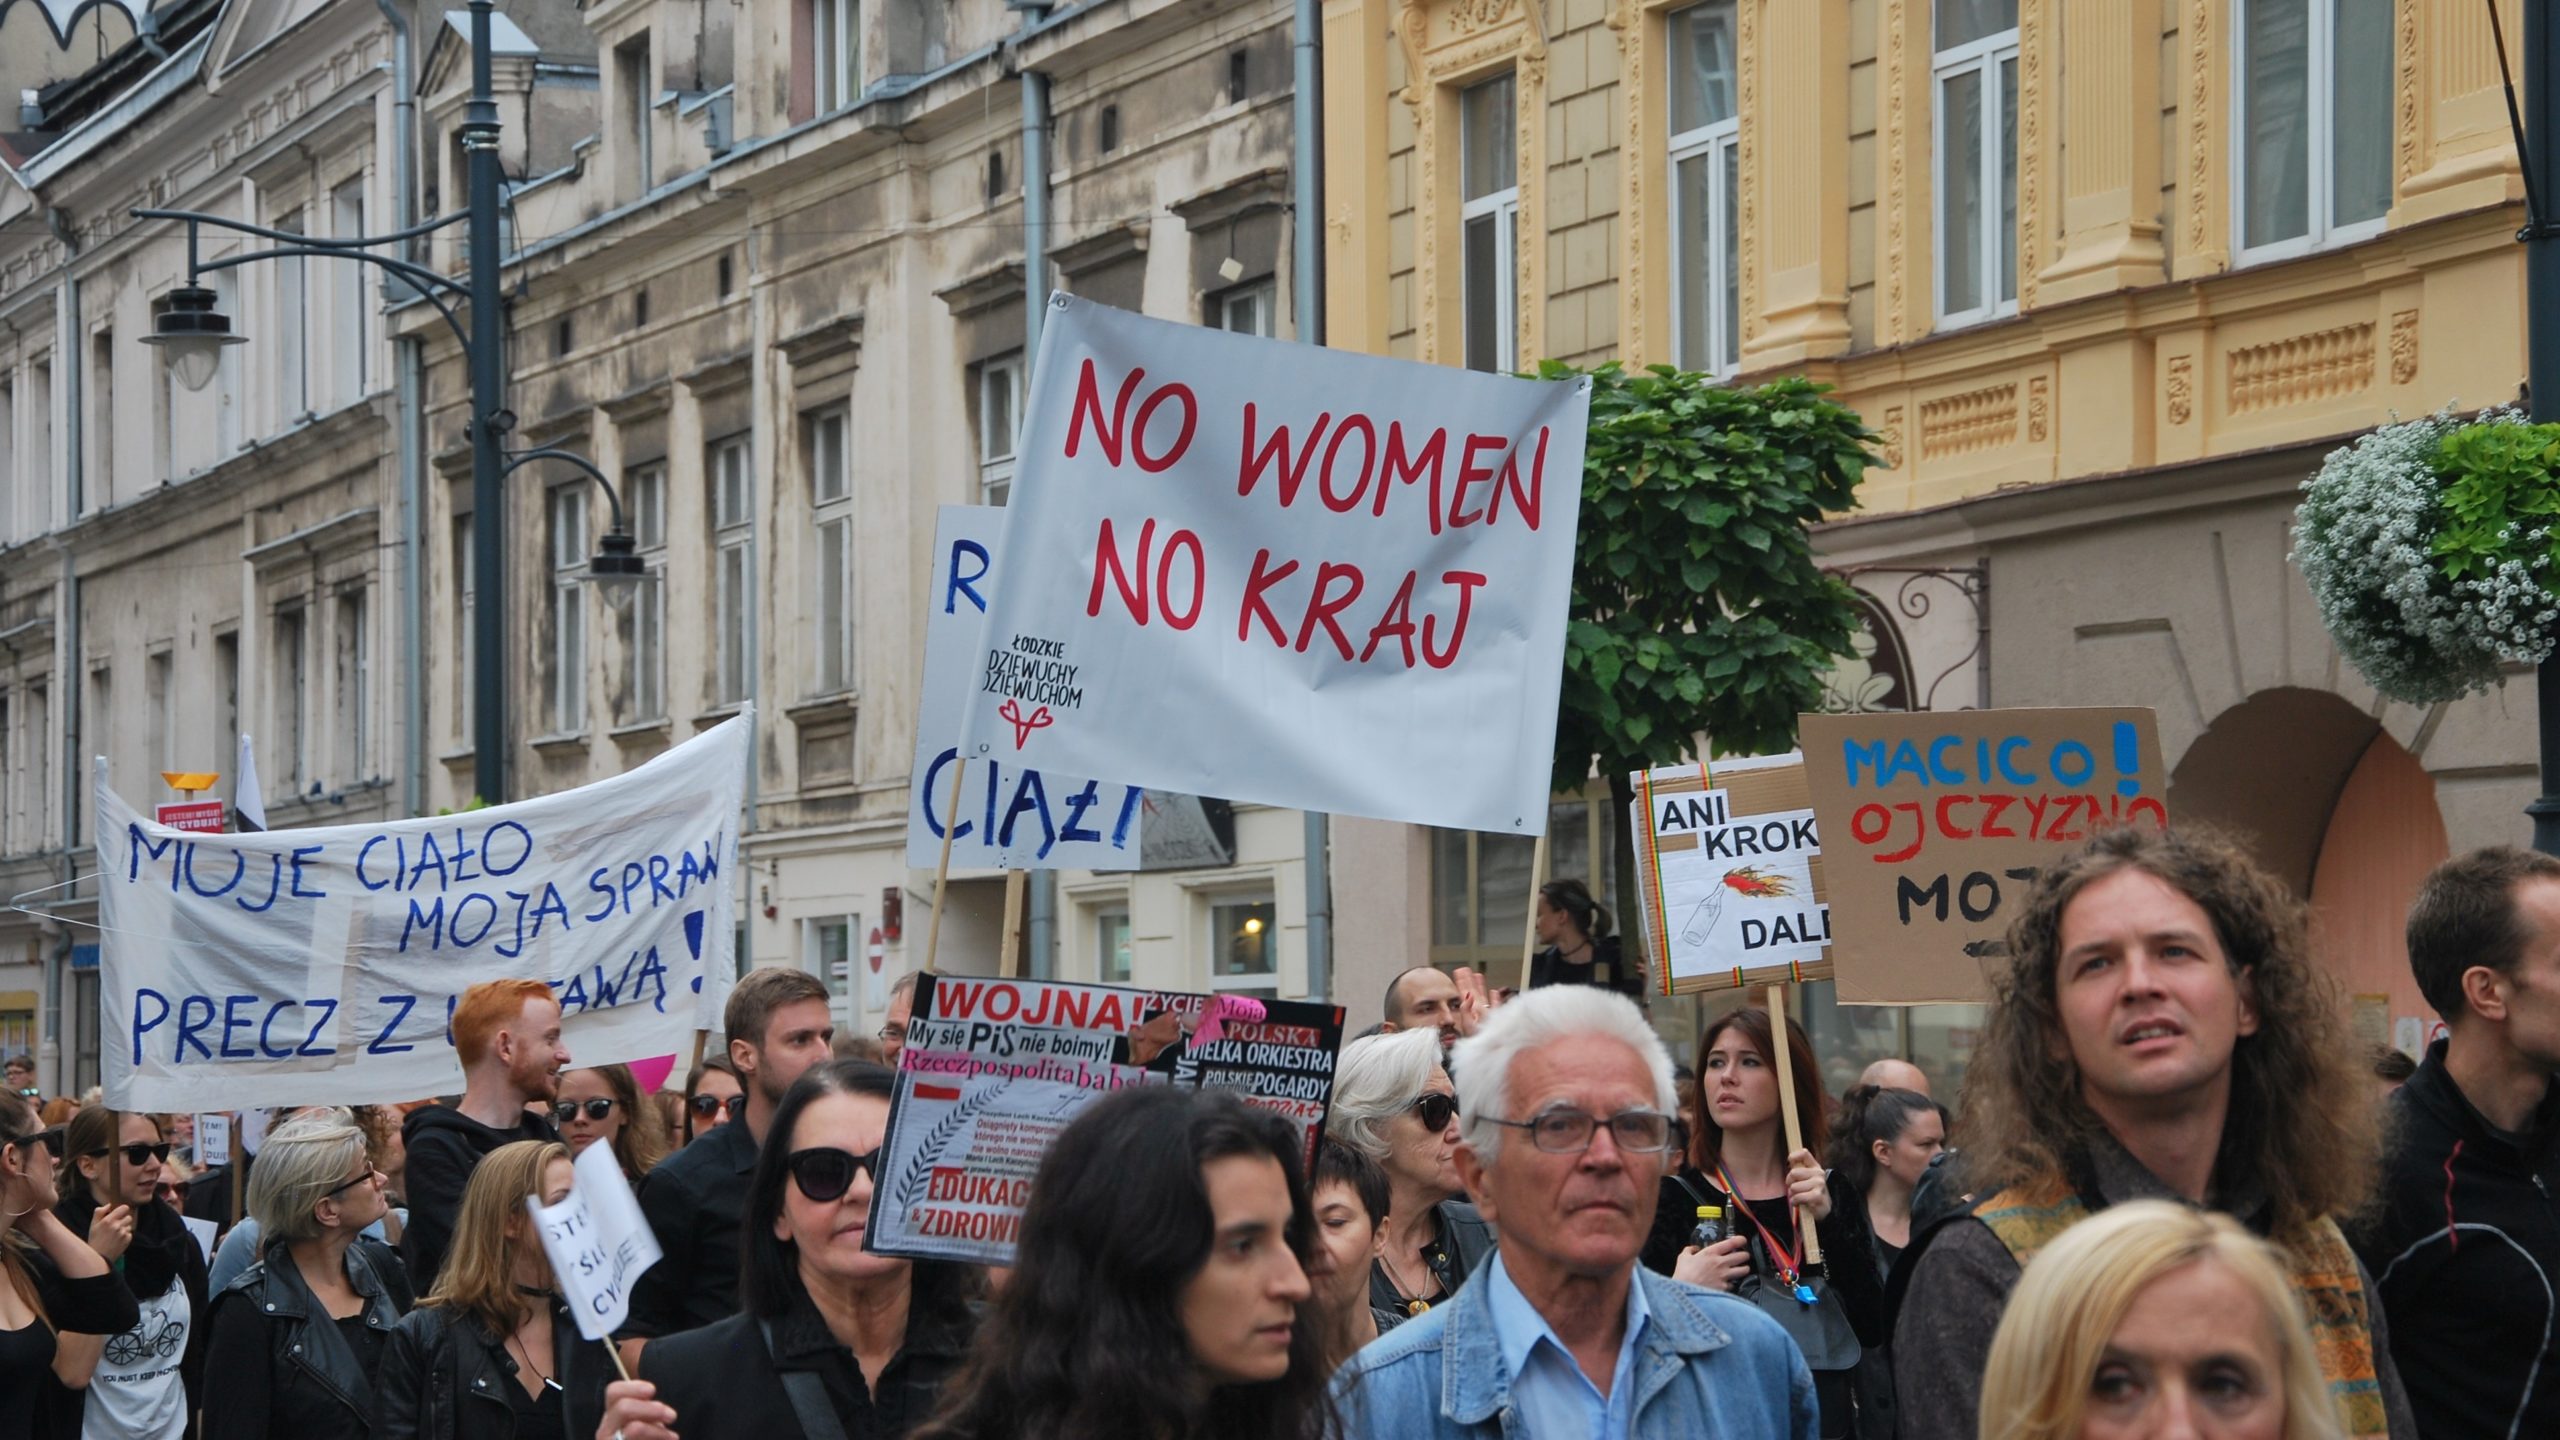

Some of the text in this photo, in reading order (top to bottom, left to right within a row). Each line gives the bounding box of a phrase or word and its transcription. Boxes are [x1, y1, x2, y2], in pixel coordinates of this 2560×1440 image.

[1064, 358, 1550, 535] NO WOMEN
[1086, 517, 1487, 669] NO KRAJ
[987, 649, 1079, 686] DZIEWUCHY
[1843, 720, 2142, 797] MACICO!
[1660, 795, 1726, 832] ANI
[1704, 818, 1820, 861] KROK
[129, 820, 533, 912] MOJE CIAŁO
[399, 881, 571, 958] MOJA
[133, 988, 339, 1066] PRECZ
[367, 994, 417, 1055] Z
[936, 981, 1144, 1031] WOJNA!
[1216, 998, 1266, 1020] Moja
[908, 1020, 1111, 1065] My się PiS nie boimy!
[1184, 1037, 1333, 1074] WIELKA ORKIESTRA
[1227, 1021, 1318, 1048] POLSKA
[1251, 1071, 1332, 1101] POGARDY
[911, 1208, 921, 1222] &
